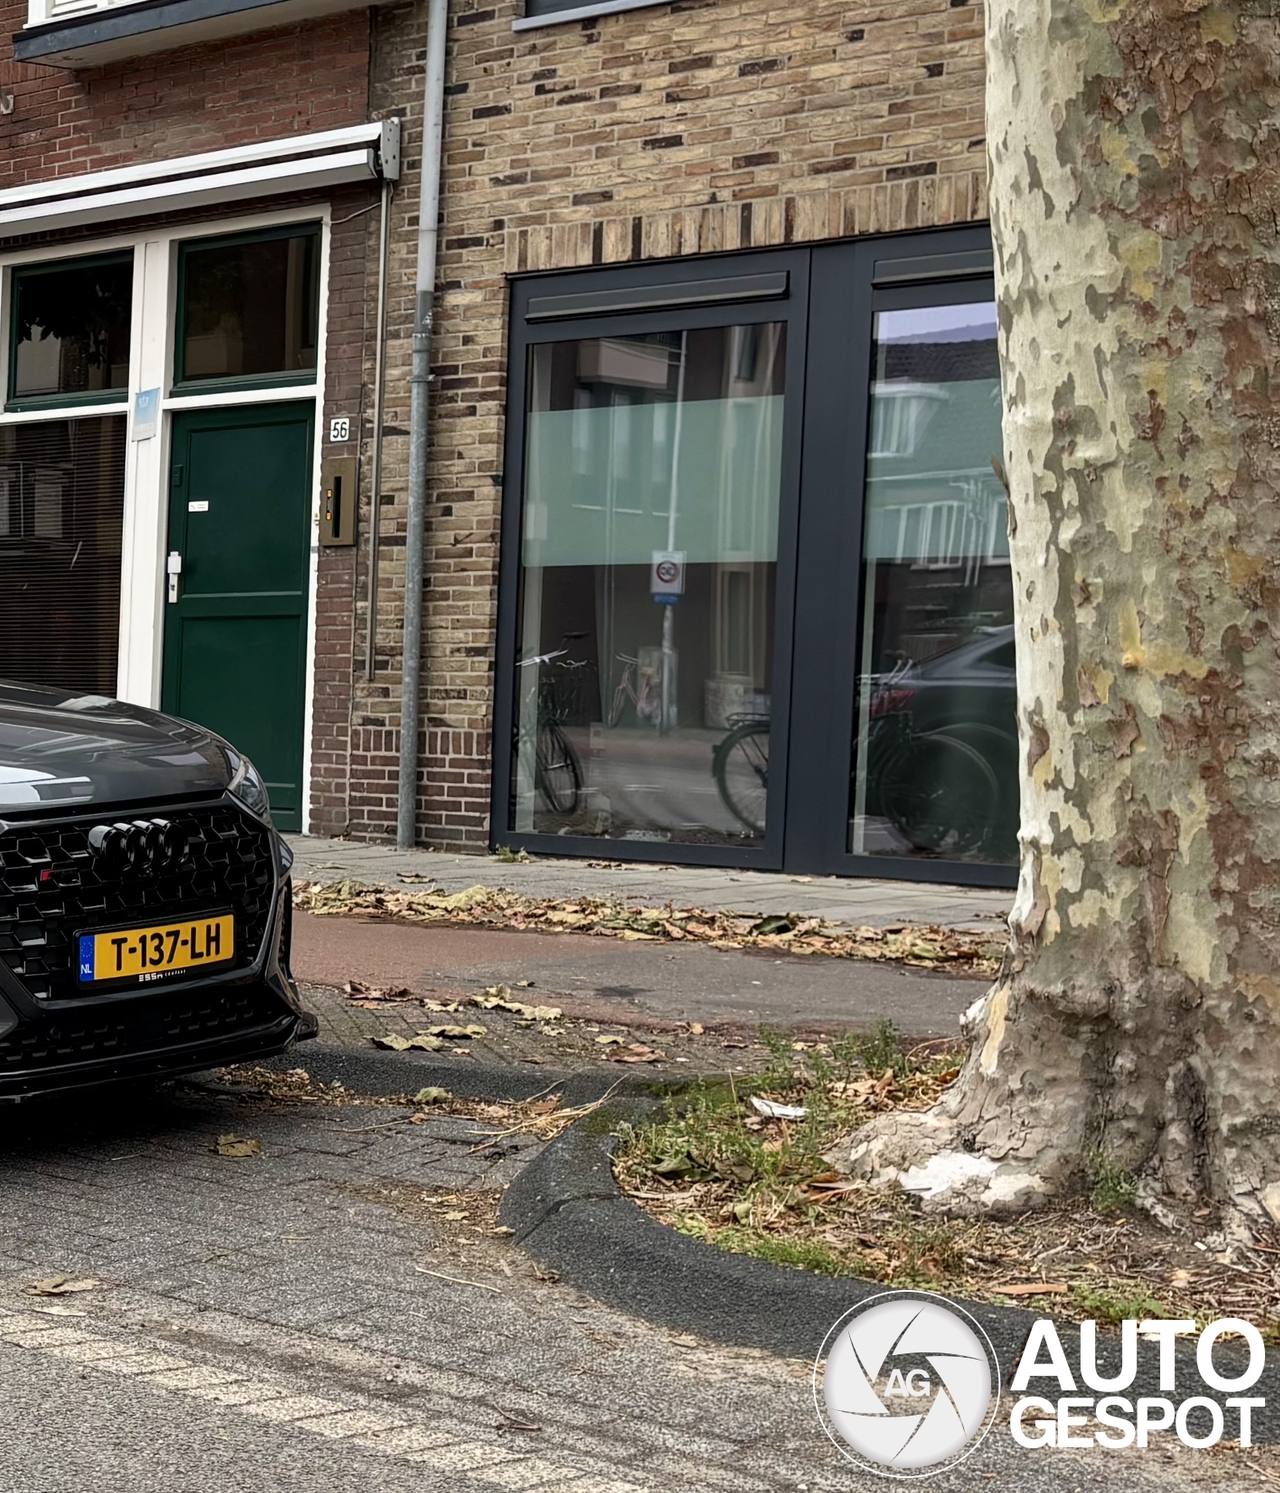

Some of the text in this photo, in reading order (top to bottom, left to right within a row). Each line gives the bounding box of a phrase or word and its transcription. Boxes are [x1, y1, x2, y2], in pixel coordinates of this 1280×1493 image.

[332, 421, 347, 439] 56
[111, 922, 221, 971] T-137-LH
[80, 963, 92, 974] NL
